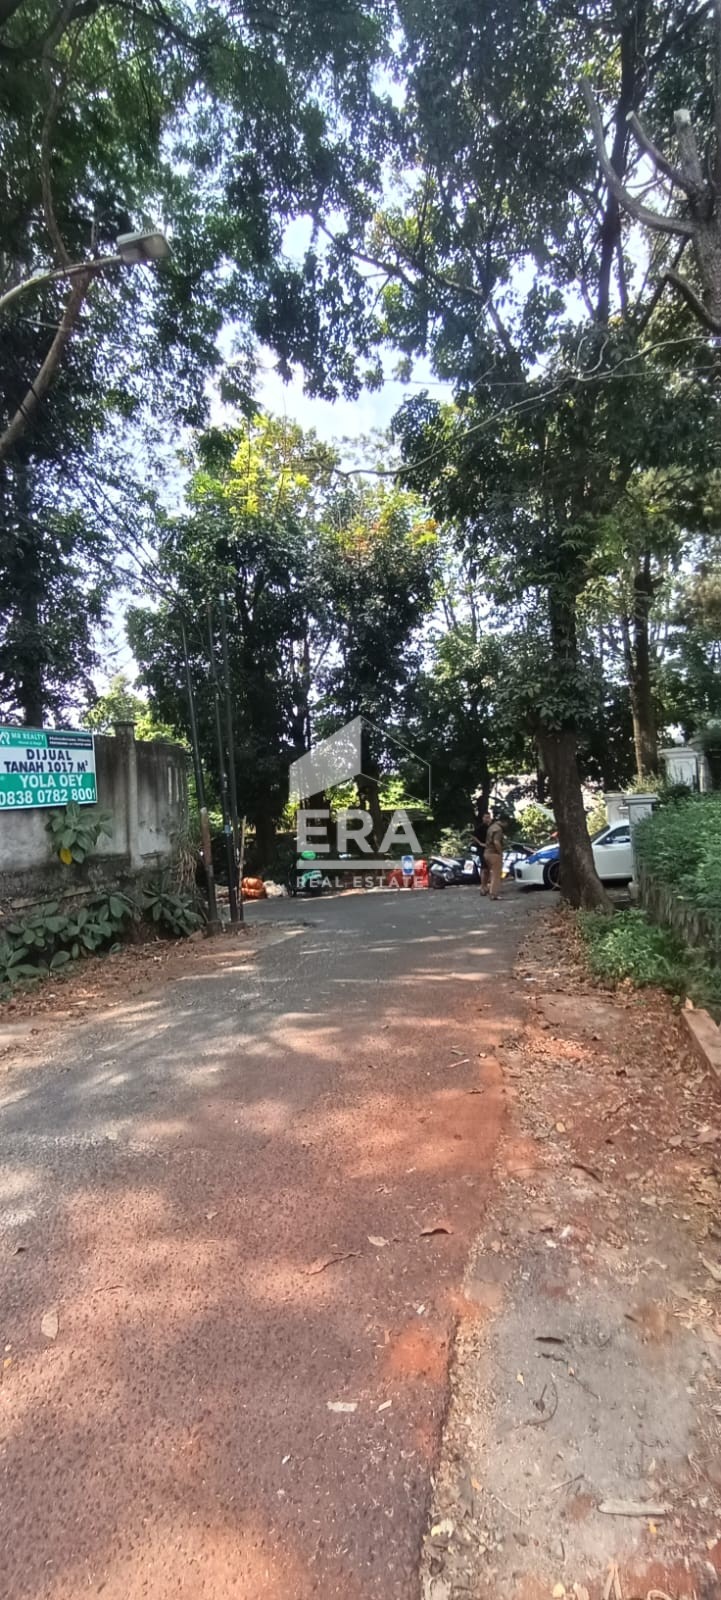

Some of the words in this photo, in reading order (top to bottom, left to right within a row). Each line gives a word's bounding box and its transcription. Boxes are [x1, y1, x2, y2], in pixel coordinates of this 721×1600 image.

[26, 749, 72, 760] DIJUAL
[4, 761, 43, 772] TANAH
[48, 762, 74, 772] 1017
[20, 775, 55, 788] YOLA
[59, 775, 83, 787] OEY
[0, 790, 33, 805] 0838
[37, 789, 68, 802] 0782
